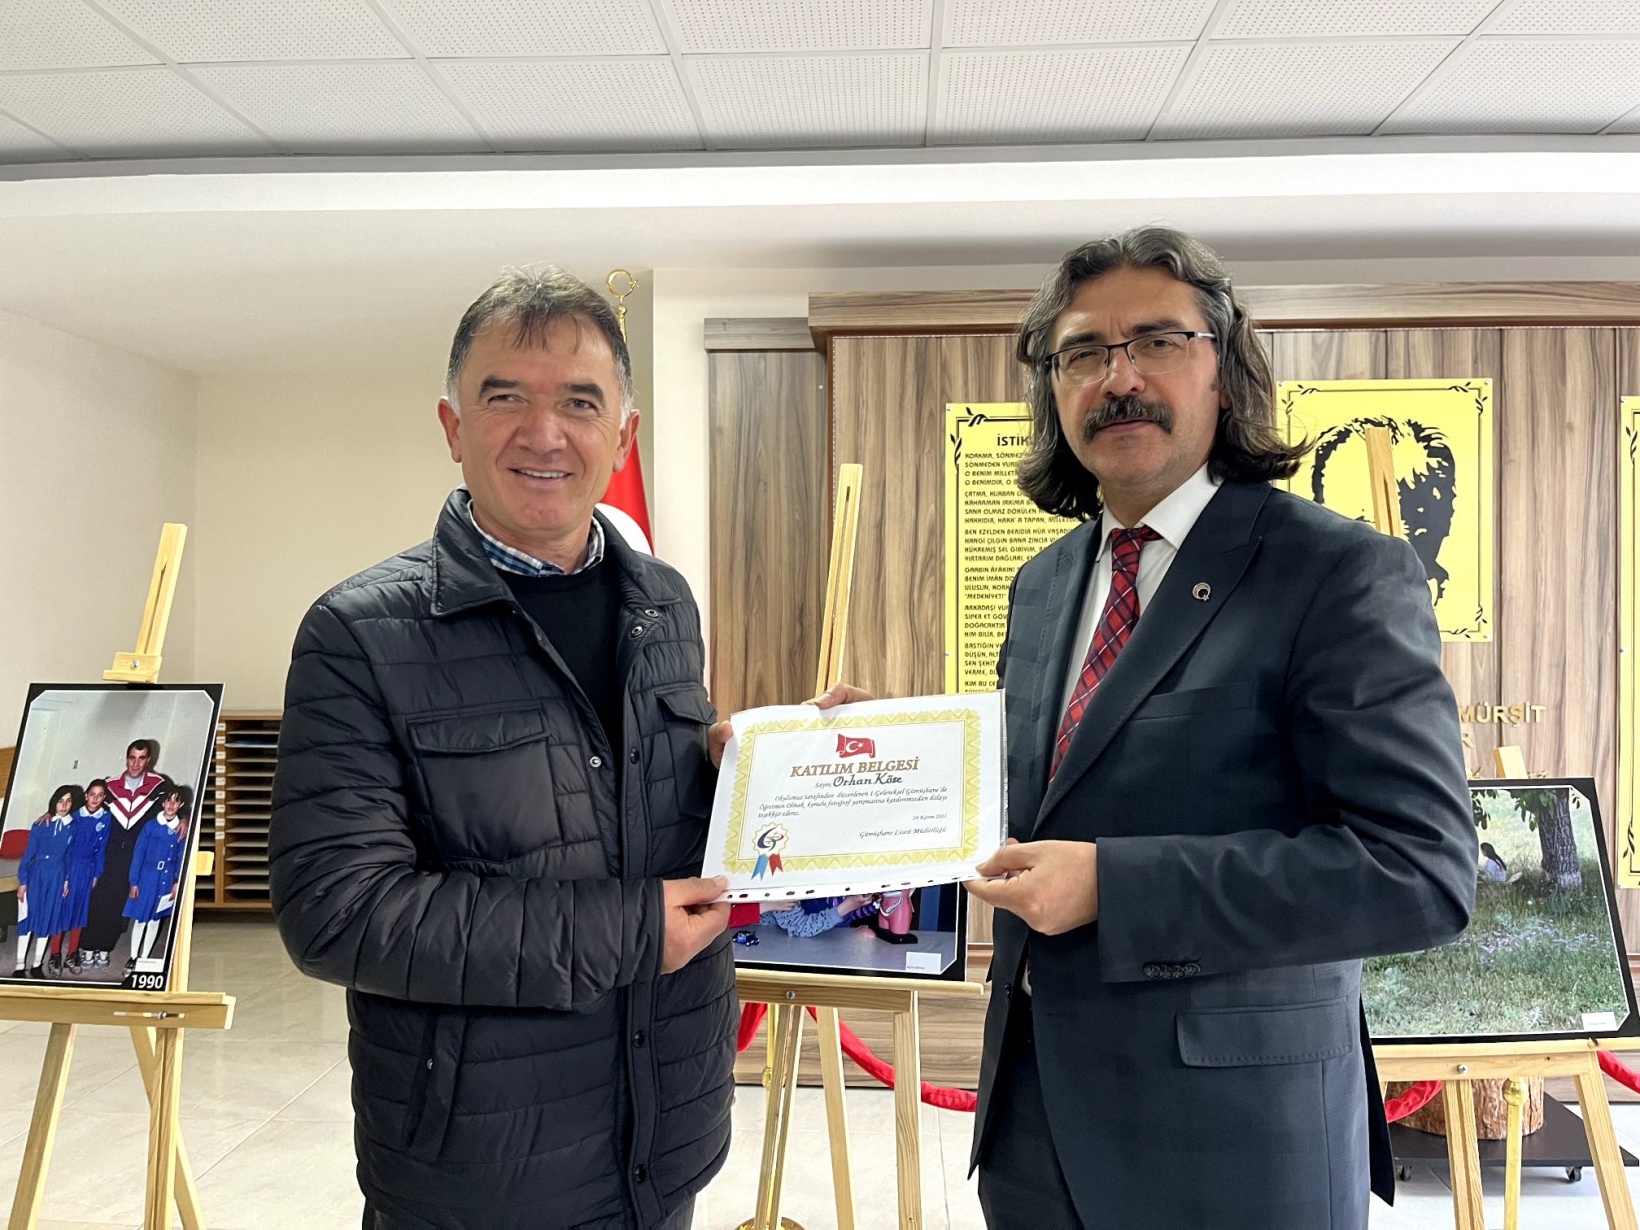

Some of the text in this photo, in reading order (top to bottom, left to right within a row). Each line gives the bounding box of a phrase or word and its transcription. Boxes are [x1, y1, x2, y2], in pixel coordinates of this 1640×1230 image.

[997, 433, 1029, 446] İSTİK
[972, 478, 1004, 486] BENİMDİR,
[965, 491, 988, 499] ÇATMA,
[1007, 507, 1036, 515] DÖKÜLEN
[965, 546, 996, 554] KÜKREMİŞ
[1010, 546, 1037, 554] GİBİYİM,
[995, 554, 1024, 562] DAĞLARI,
[965, 621, 1005, 629] DOĞACAKTIR
[965, 641, 994, 649] BASTIĞIN
[965, 650, 988, 660] DÜŞÜN,
[978, 659, 995, 668] ŞEHİT
[1460, 701, 1546, 728] MÜRŞİT
[790, 756, 920, 777] KATILIM BELGESİ
[832, 774, 872, 788] Orhan
[804, 792, 835, 801] tarafından
[836, 790, 868, 799] düzenlenen
[759, 802, 786, 811] Öğretmen
[807, 800, 826, 808] konulu
[826, 799, 850, 809] fotoğraf
[758, 810, 782, 818] teşekkür
[859, 827, 947, 840] Gümüşhane Lisesi Müdürlüğü
[131, 974, 164, 989] 1990
